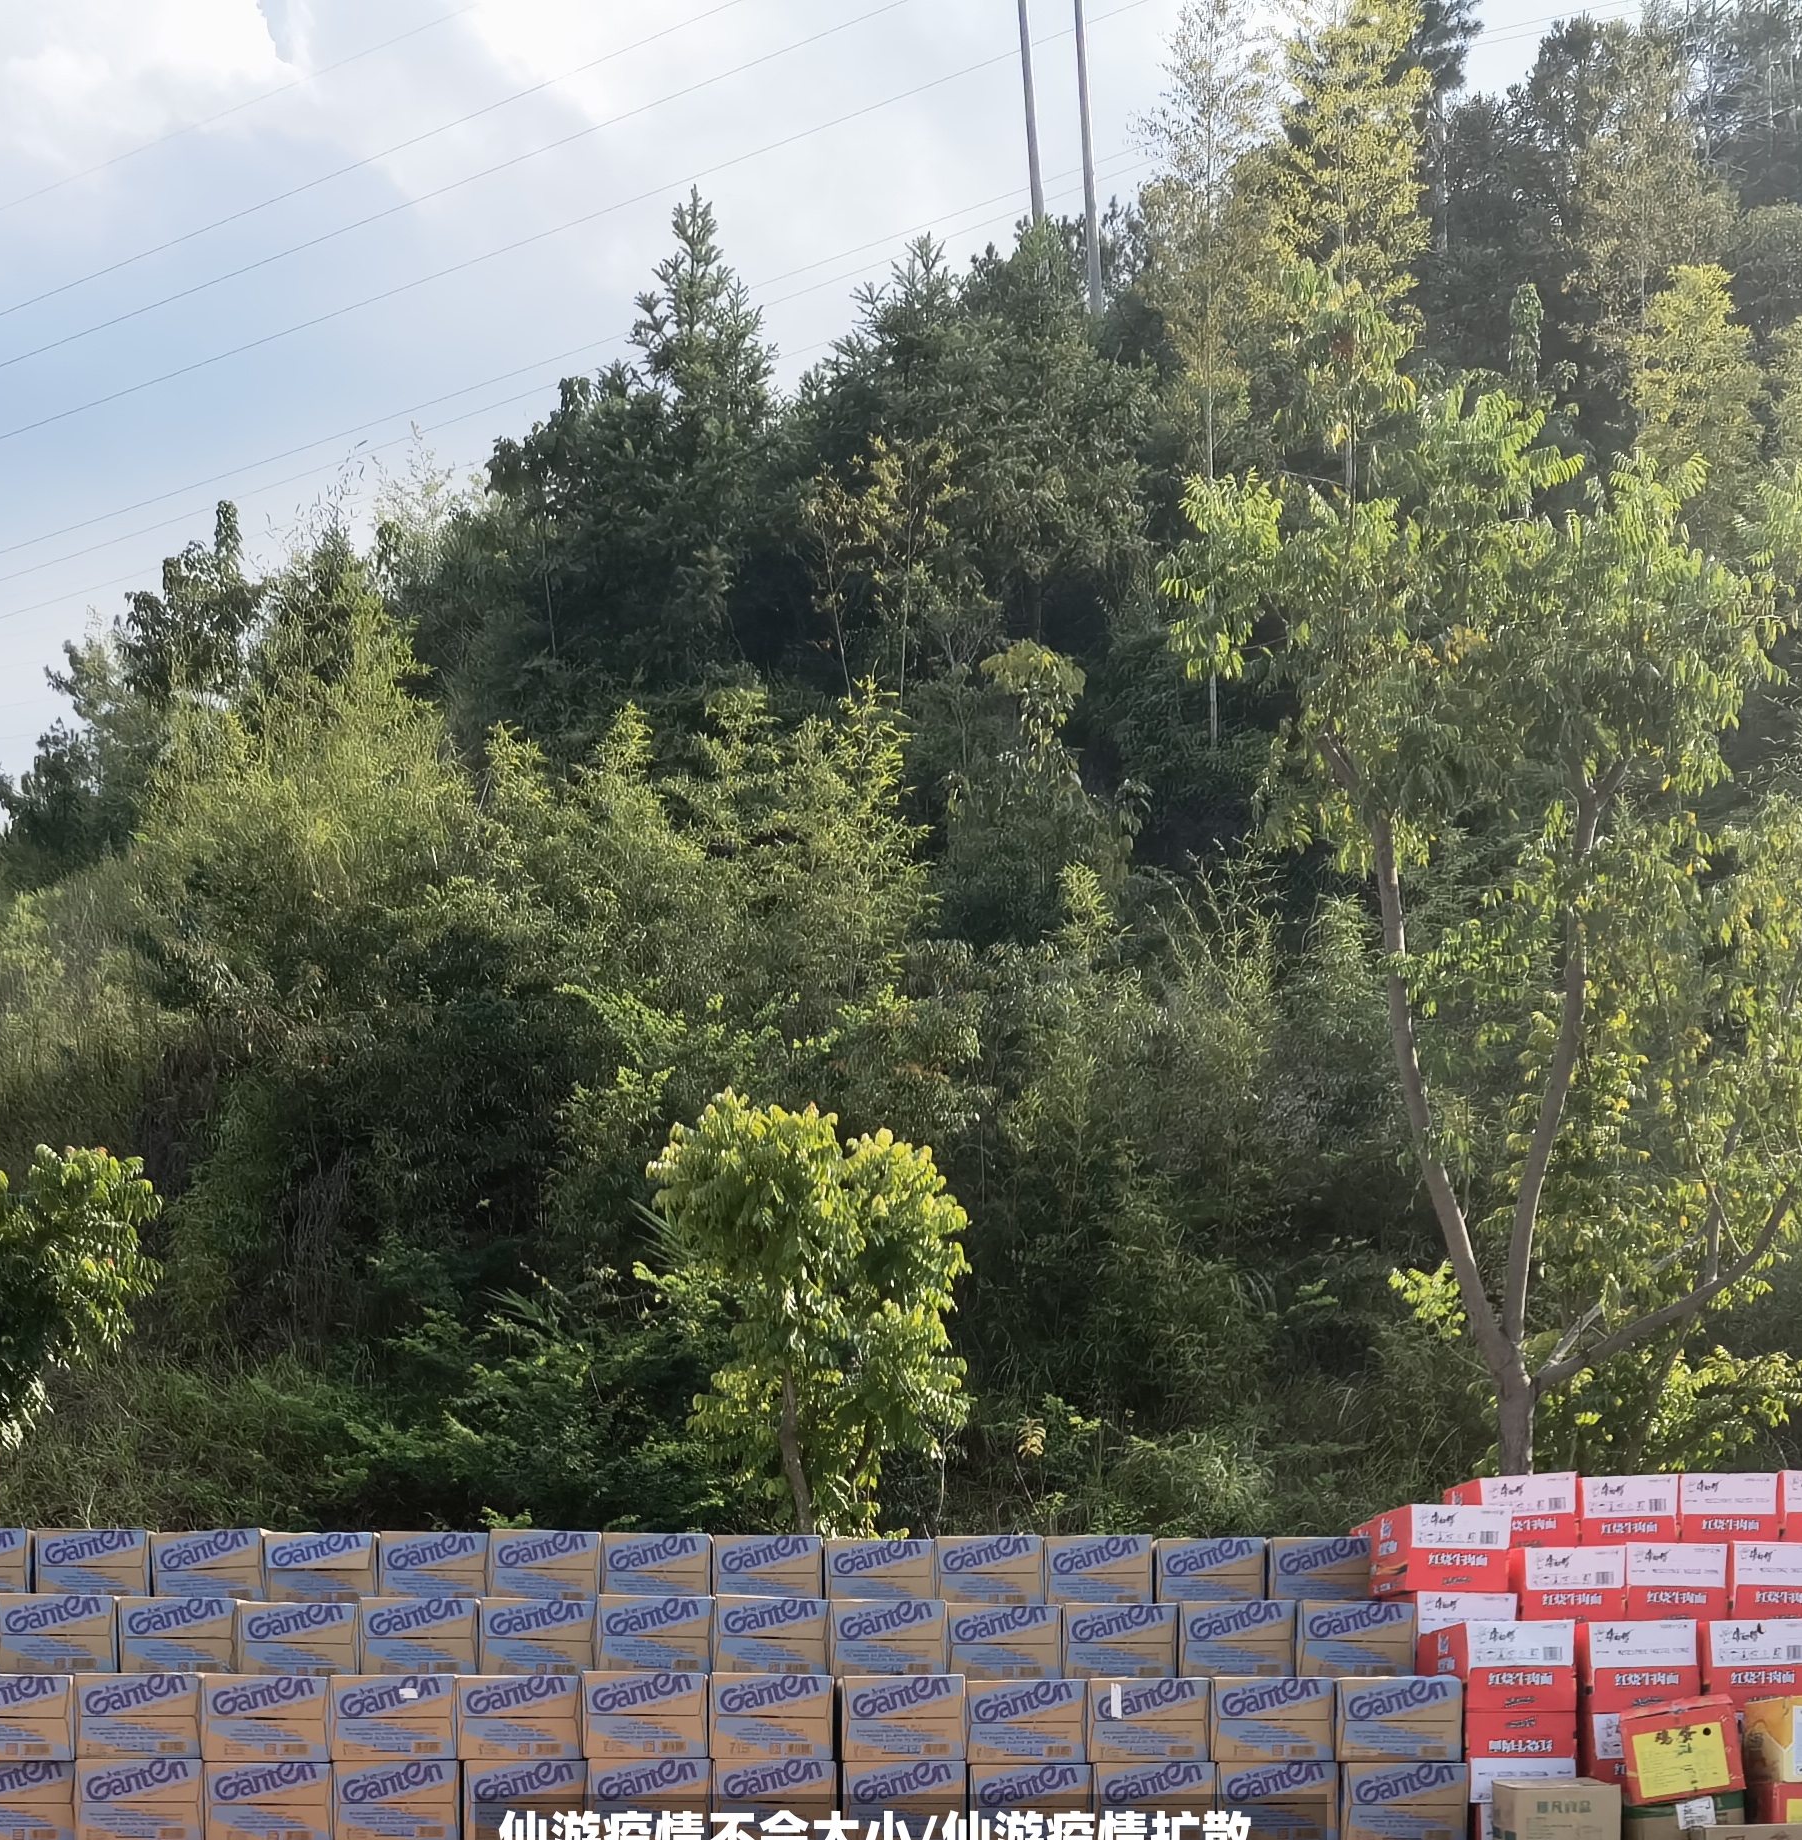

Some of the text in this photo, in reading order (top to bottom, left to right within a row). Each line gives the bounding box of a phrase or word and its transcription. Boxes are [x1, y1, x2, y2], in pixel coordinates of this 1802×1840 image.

[45, 1530, 136, 1565] Ganten
[498, 1532, 589, 1569] Ganten
[609, 1534, 698, 1574] Ganten
[722, 1536, 811, 1576] Ganten
[1053, 1536, 1141, 1577] Ganten
[1166, 1538, 1255, 1579] Ganten
[4, 1594, 103, 1638] Ganten
[248, 1604, 345, 1641] Ganten
[490, 1594, 585, 1637] Ganten
[606, 1597, 701, 1637] Ganten
[840, 1600, 934, 1643] Ganten
[955, 1605, 1048, 1643] Ganten
[1190, 1598, 1283, 1644] Ganten
[1309, 1602, 1405, 1639] Ganten
[212, 1676, 317, 1716] Ganten
[592, 1671, 693, 1714] Ganten
[720, 1674, 821, 1714] Ganten
[974, 1680, 1074, 1726] Ganten
[1222, 1677, 1323, 1717] Ganten
[1349, 1679, 1449, 1724] Ganten
[86, 1756, 190, 1803] Ganten
[342, 1761, 445, 1806] Ganten
